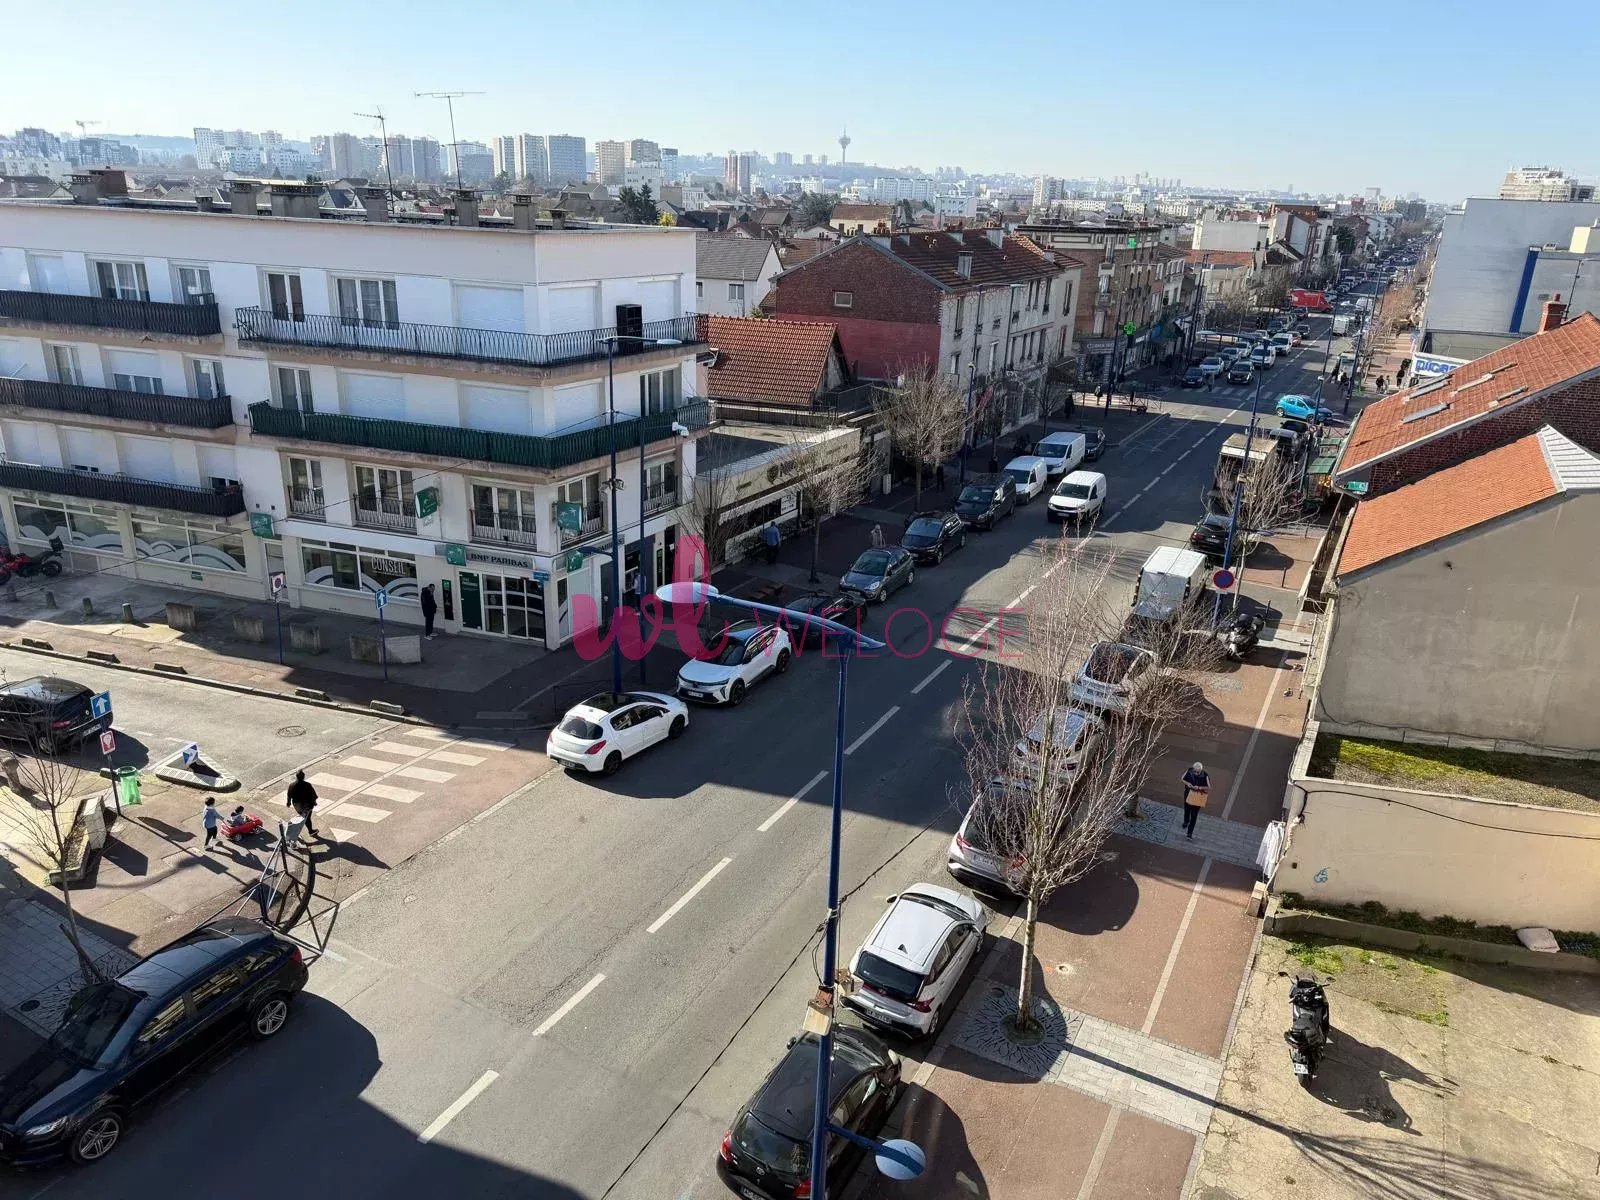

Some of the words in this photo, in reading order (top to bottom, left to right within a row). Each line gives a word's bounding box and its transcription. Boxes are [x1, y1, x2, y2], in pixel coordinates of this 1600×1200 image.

[371, 557, 406, 575] CONSEIL
[471, 553, 489, 561] BNP
[491, 556, 528, 568] PARIBAS
